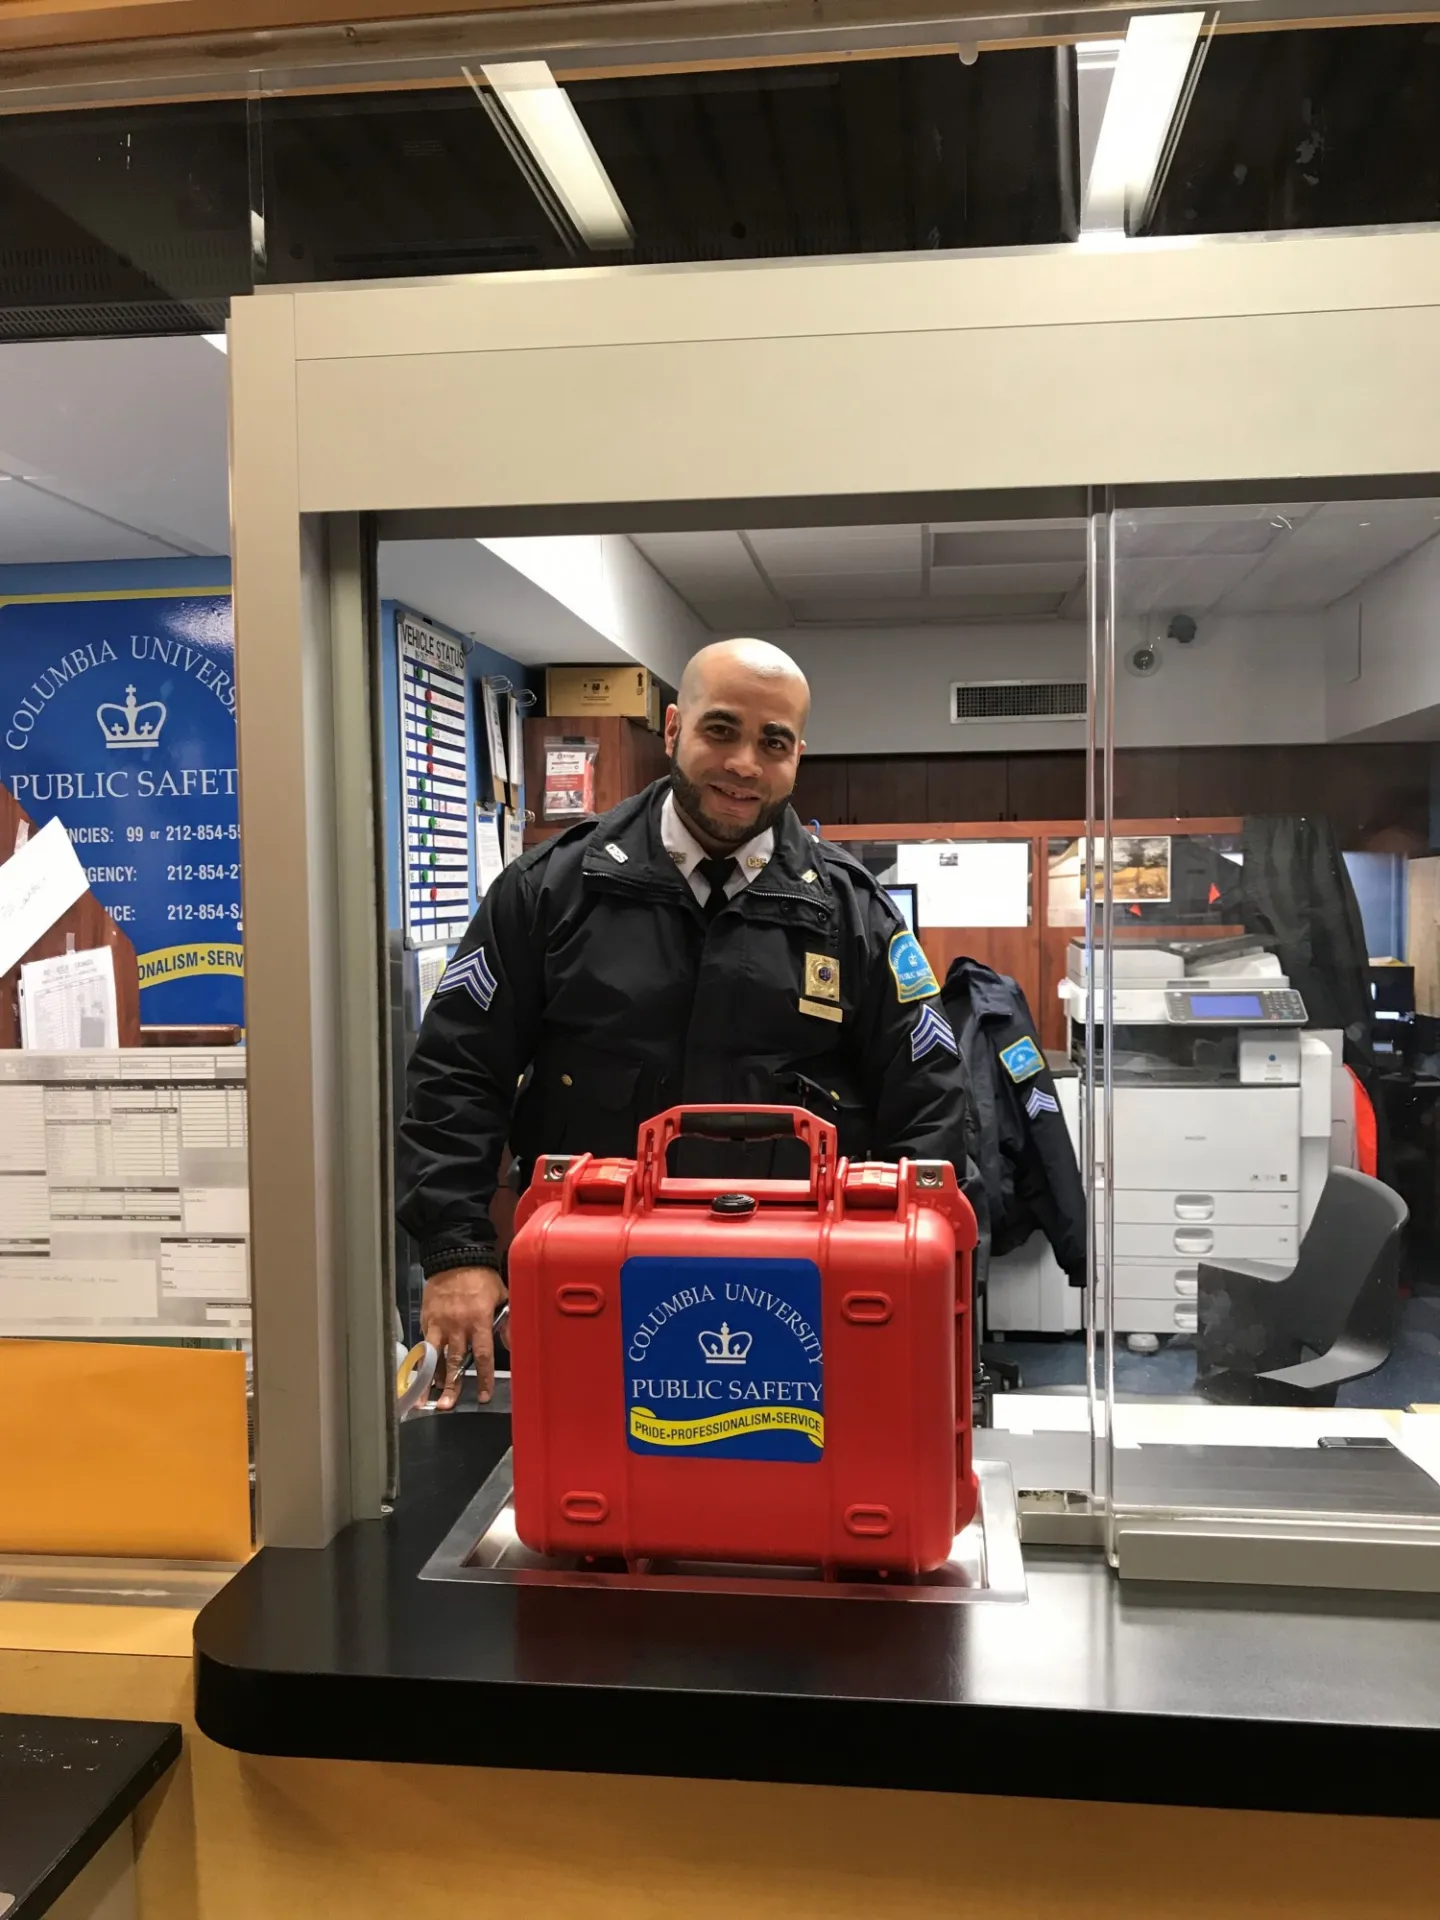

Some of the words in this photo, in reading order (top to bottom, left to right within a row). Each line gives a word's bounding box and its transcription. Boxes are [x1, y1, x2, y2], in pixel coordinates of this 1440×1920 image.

[402, 624, 434, 656] VEHICLE
[437, 641, 465, 669] STATUS
[6, 639, 118, 750] COLUMBIA
[10, 771, 129, 801] PUBLIC
[65, 827, 114, 843] NCIES:
[126, 826, 144, 842] 99
[150, 830, 160, 840] or
[167, 864, 242, 881] 212-854-2
[104, 906, 136, 921] ICE:
[167, 903, 243, 920] 212-854-S
[629, 1284, 716, 1362] COLUMBIA
[725, 1283, 824, 1365] UNIVERSITY
[632, 1378, 723, 1399] PUBLIC
[729, 1379, 823, 1402] SAFETY
